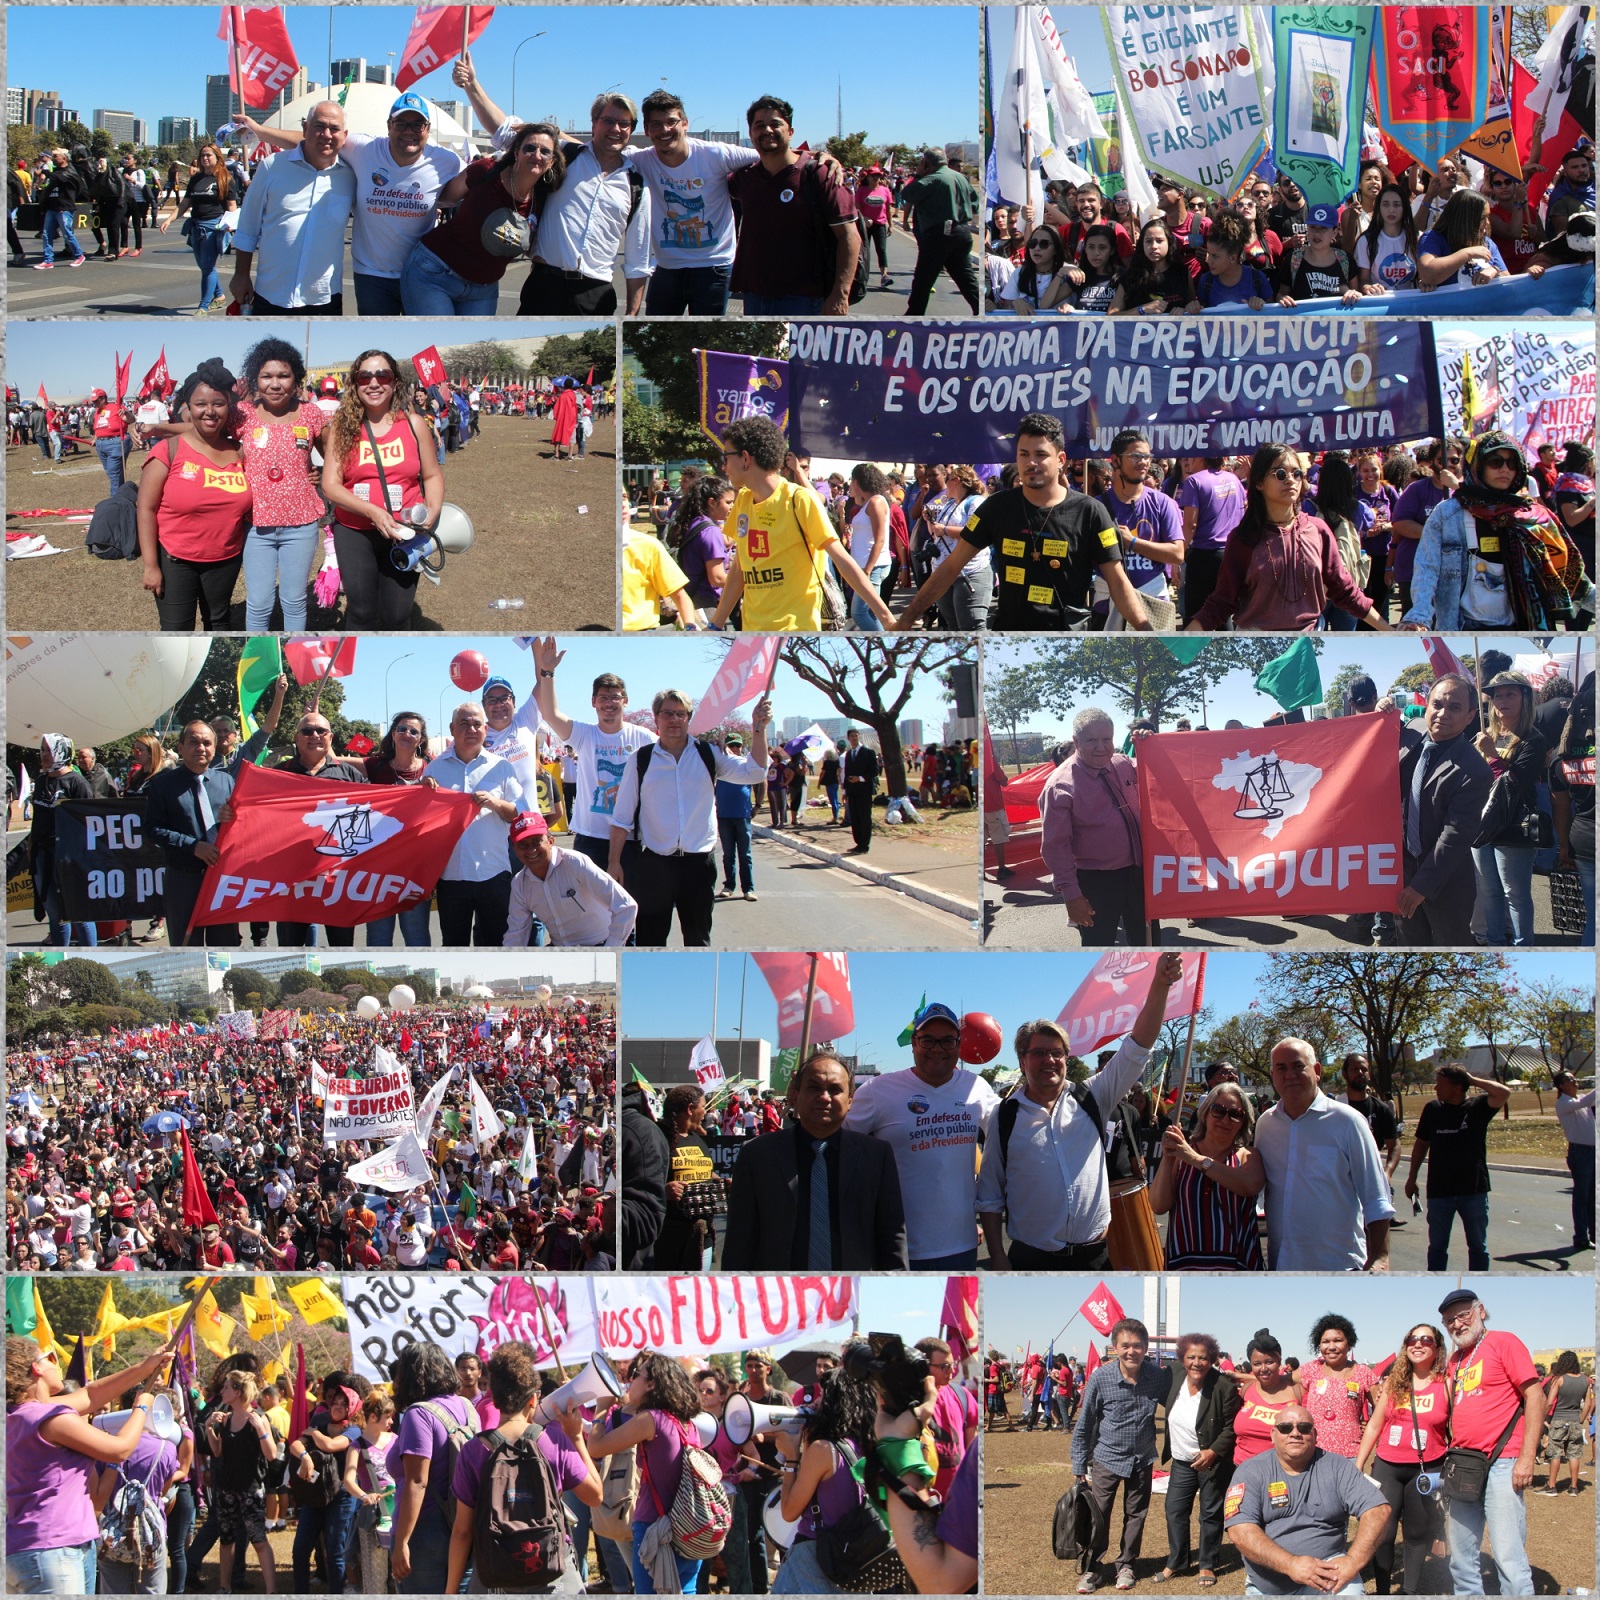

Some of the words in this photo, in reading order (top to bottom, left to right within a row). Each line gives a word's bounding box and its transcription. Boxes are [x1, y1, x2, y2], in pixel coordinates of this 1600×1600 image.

[1121, 31, 1138, 57] É
[1397, 29, 1418, 50] O
[1398, 56, 1446, 76] SACI
[1177, 90, 1192, 117] É
[1197, 87, 1228, 113] UM
[1146, 104, 1263, 157] FARSANTE
[1198, 158, 1234, 186] UJS
[366, 197, 396, 208] serviço
[397, 200, 429, 210] público
[372, 187, 385, 197] Em
[386, 189, 413, 199] defesa
[413, 191, 424, 200] do
[372, 206, 382, 214] da
[789, 323, 883, 367] CONTRA
[892, 331, 914, 369] A
[922, 325, 1060, 370] REFORMA
[1075, 321, 1116, 360] DA
[1511, 331, 1549, 359] luta
[1497, 350, 1560, 392] rruba
[1561, 339, 1578, 354] a
[717, 388, 776, 414] vamos
[884, 376, 905, 412] E
[918, 377, 961, 414] OS
[969, 366, 1092, 413] CORTES
[1105, 366, 1152, 405] NA
[715, 403, 731, 424] a
[1501, 396, 1520, 413] da
[1221, 419, 1301, 448] VAMOS
[1309, 416, 1326, 443] A
[1335, 411, 1395, 441] LUTA
[364, 444, 401, 460] PTU
[208, 474, 245, 487] PSTU
[744, 566, 785, 585] untos
[6, 654, 43, 685] ervidores
[43, 644, 58, 656] da
[85, 813, 143, 850] PEC
[1152, 843, 1399, 898] FENAJUFE
[87, 868, 125, 900] ao
[209, 869, 425, 911] FEAJUFE
[328, 1072, 401, 1096] BALBURDIA
[348, 1090, 410, 1116] GOVERNO
[329, 1114, 351, 1128] NÃO
[354, 1116, 376, 1128] AOS
[916, 1116, 930, 1127] Em
[931, 1112, 960, 1124] defesa
[961, 1111, 972, 1121] do
[909, 1125, 945, 1140] serviço
[911, 1144, 917, 1152] e
[919, 1140, 931, 1151] da
[674, 1158, 684, 1167] da
[598, 1305, 665, 1349] NOSSO
